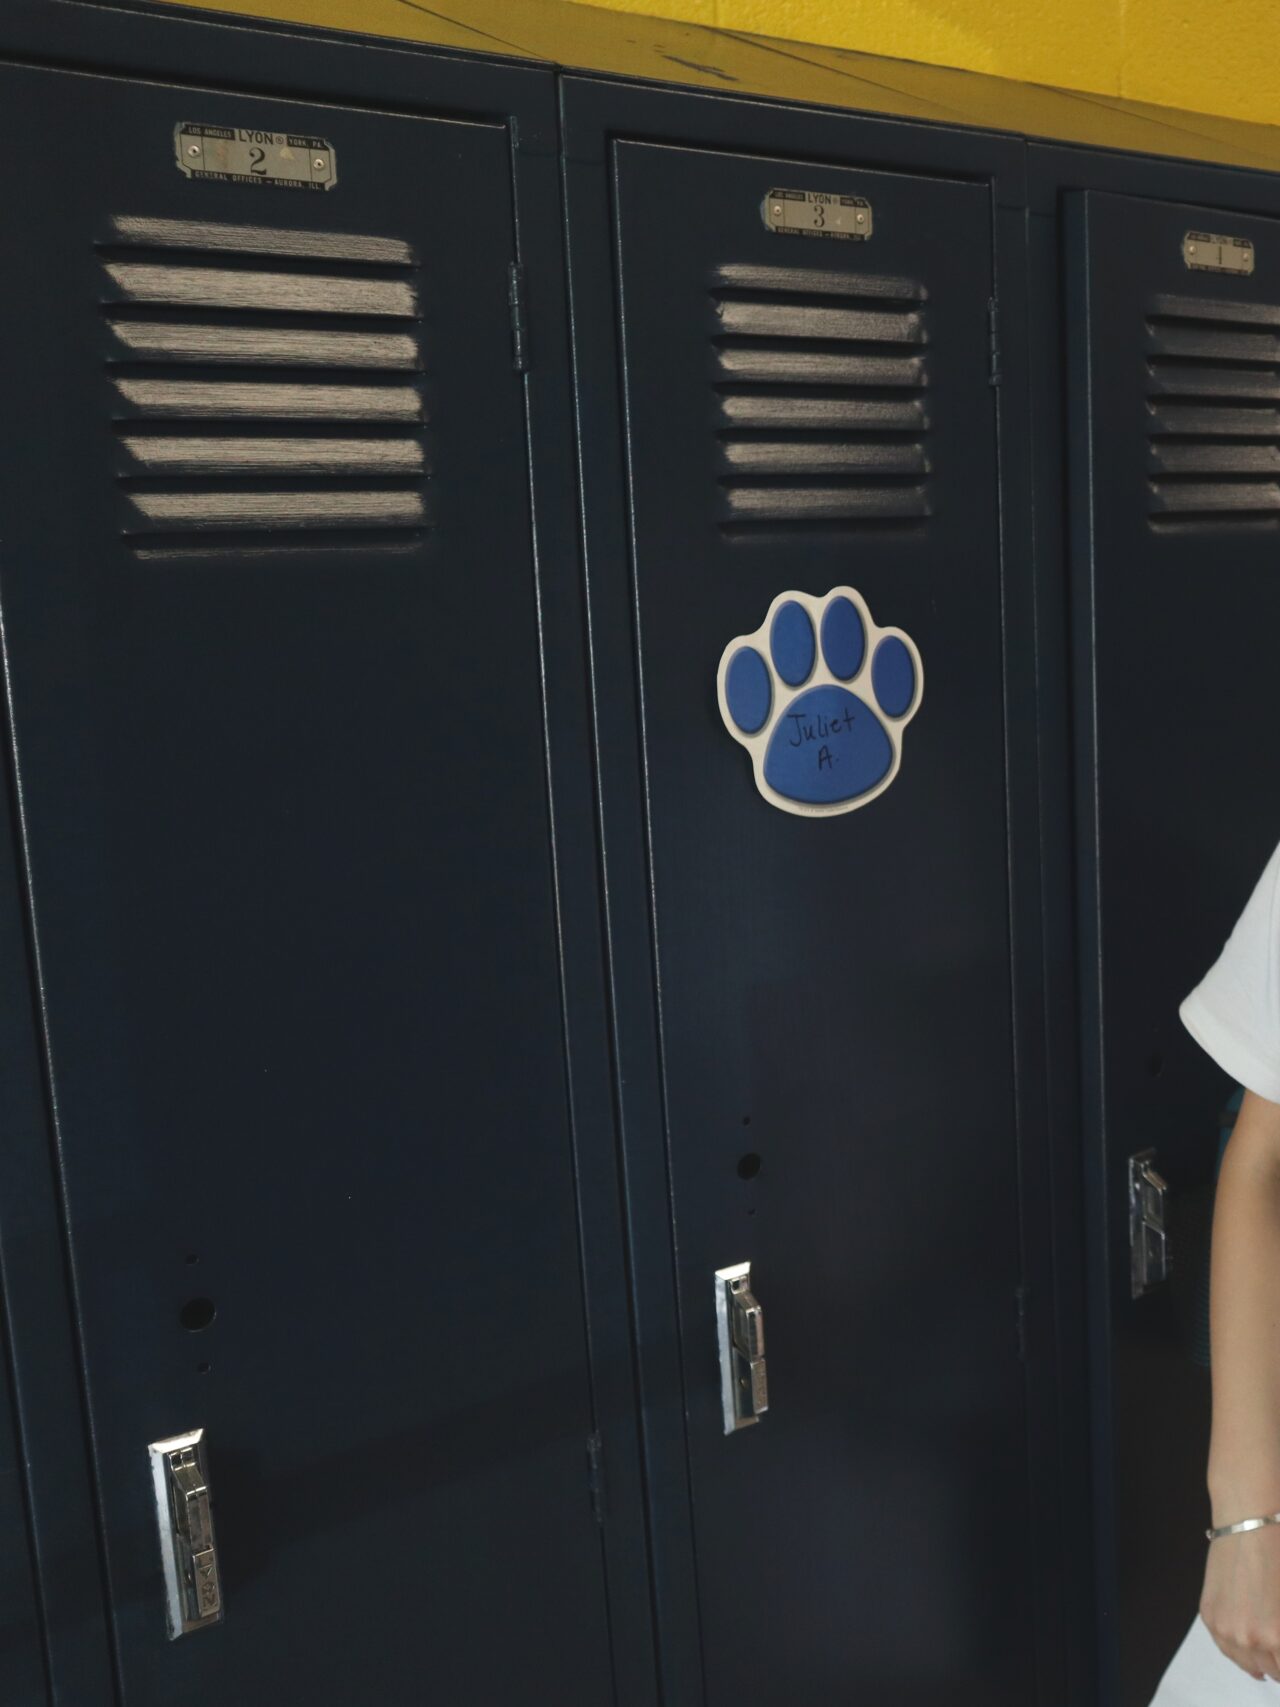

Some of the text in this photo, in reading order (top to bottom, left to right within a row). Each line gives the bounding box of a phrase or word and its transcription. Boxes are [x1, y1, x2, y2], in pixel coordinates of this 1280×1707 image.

[249, 147, 267, 175] 2
[813, 205, 825, 228] 3
[786, 707, 857, 748] Juliet
